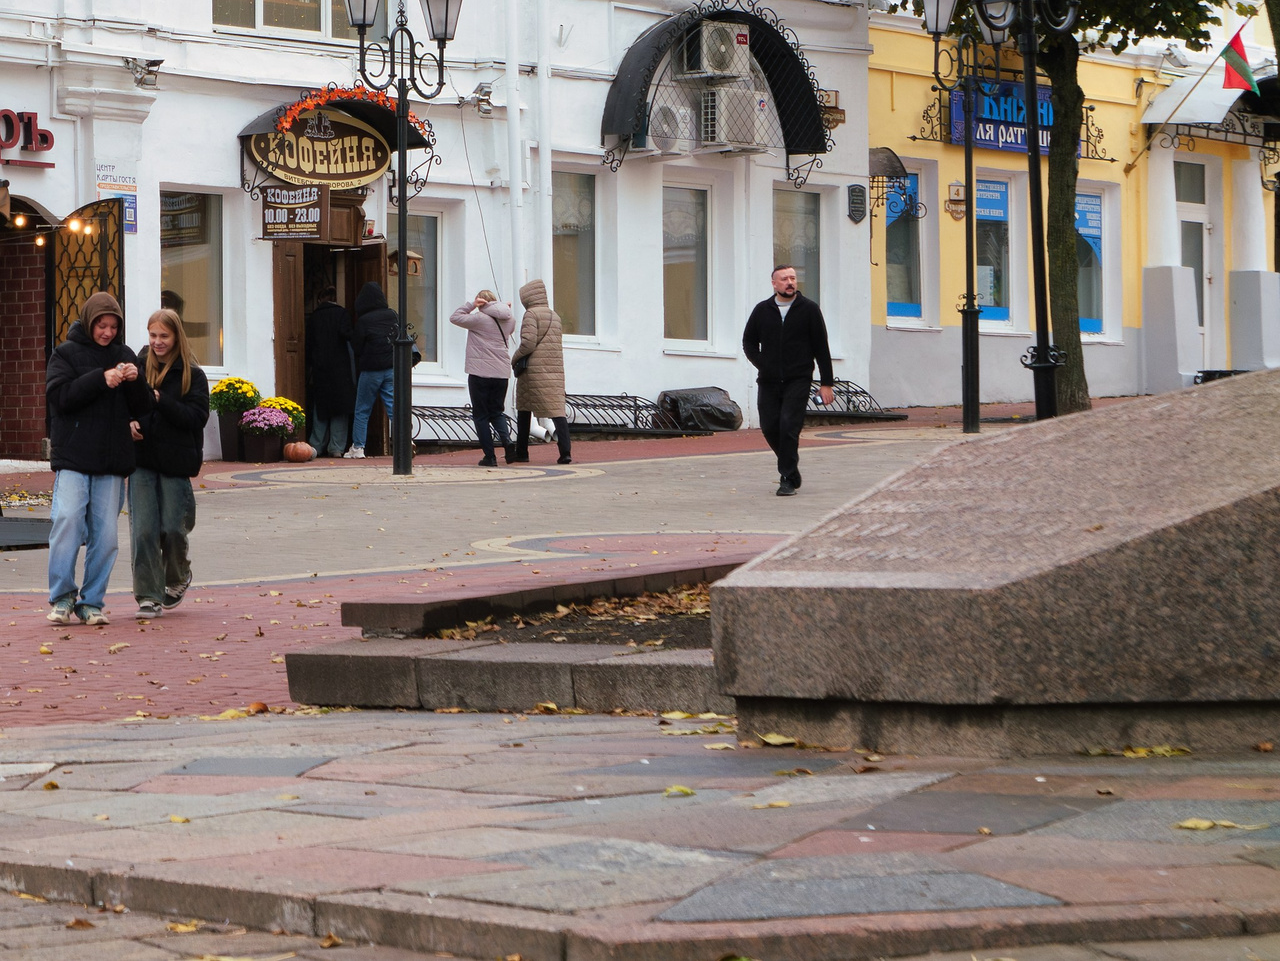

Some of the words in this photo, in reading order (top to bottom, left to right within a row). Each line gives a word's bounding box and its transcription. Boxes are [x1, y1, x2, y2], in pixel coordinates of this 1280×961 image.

[824, 94, 831, 104] 2
[267, 132, 376, 174] КОФЕЙНЯ
[96, 164, 116, 173] ЦЕНТР
[96, 174, 118, 183] КАРТЫ
[119, 176, 137, 185] ГОСТЯ
[954, 188, 961, 197] 4
[264, 208, 288, 223] 10.00
[295, 207, 320, 222] 23.00
